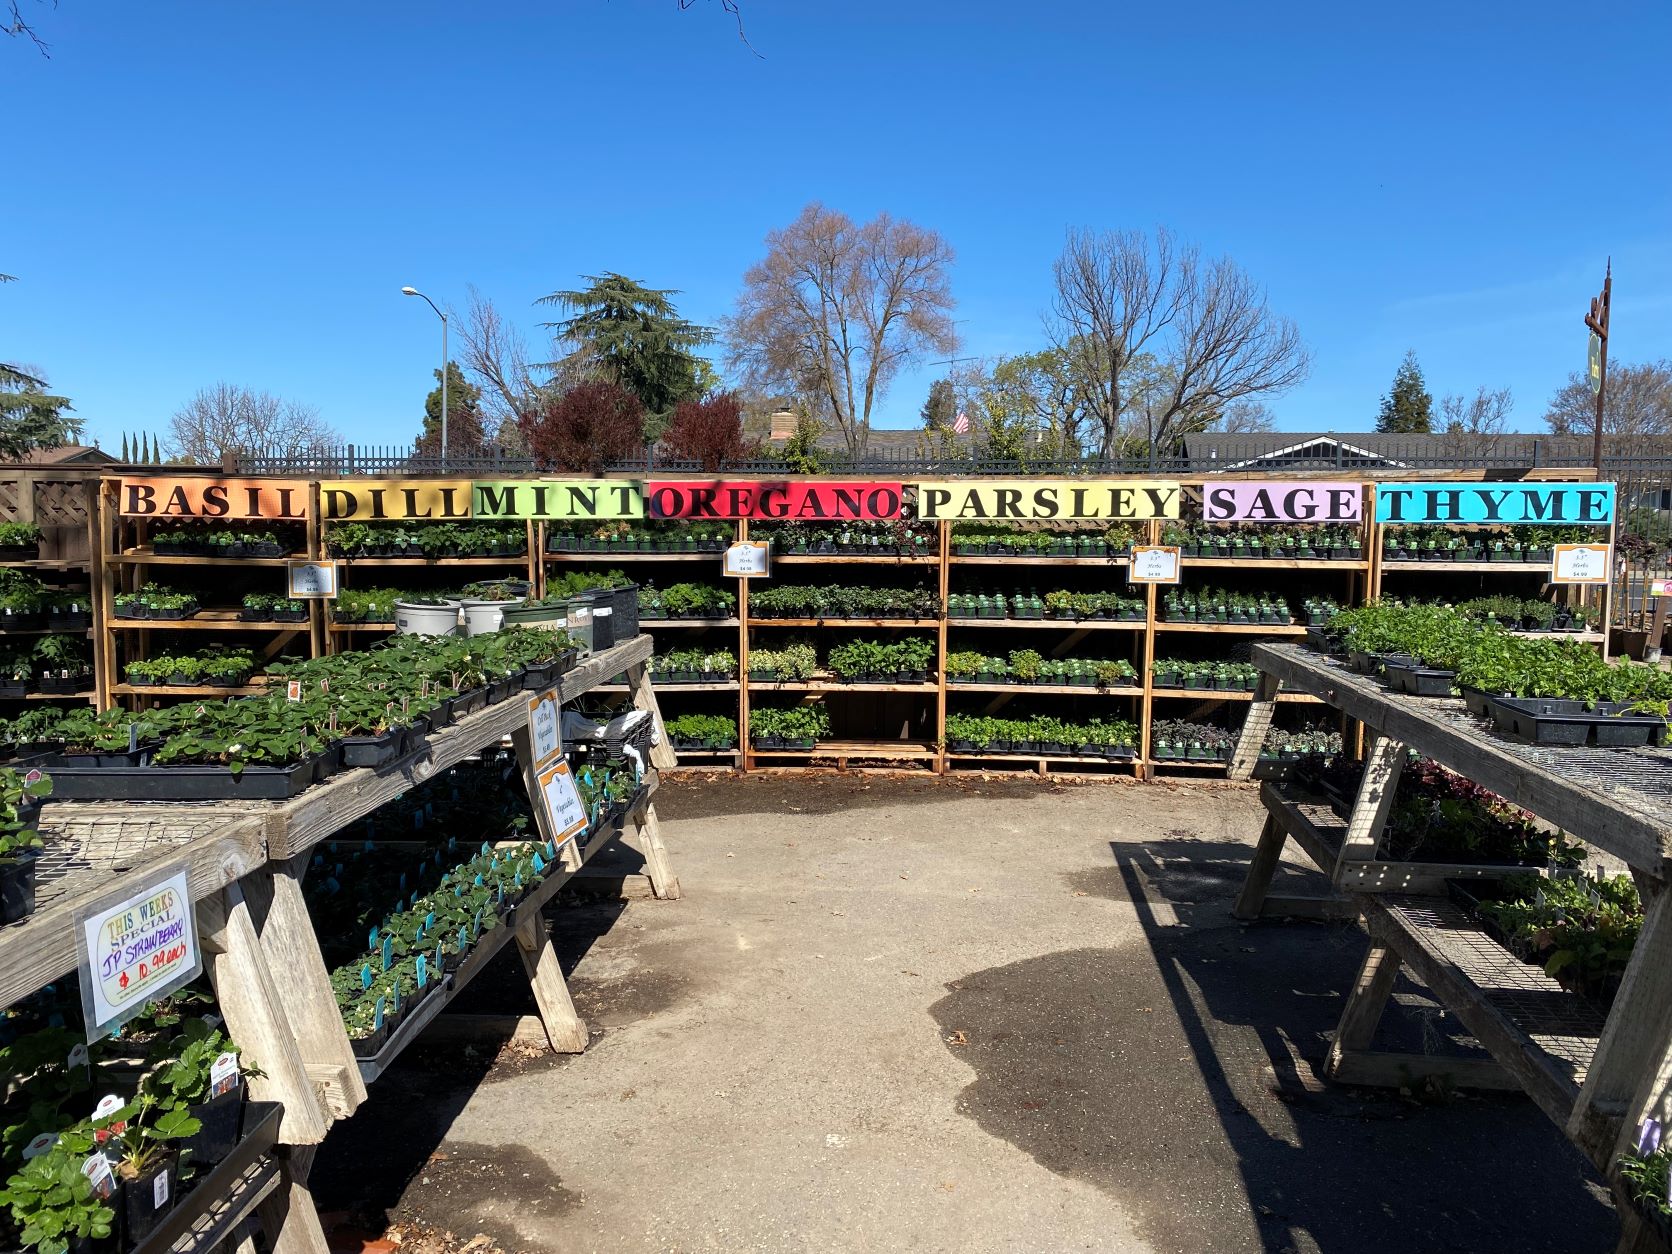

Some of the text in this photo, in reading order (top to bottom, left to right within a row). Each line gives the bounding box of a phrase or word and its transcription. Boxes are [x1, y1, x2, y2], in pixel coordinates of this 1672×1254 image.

[124, 485, 306, 519] BASIL
[323, 487, 469, 520] DILL
[474, 485, 642, 517] MINT
[651, 487, 900, 520] OREGANO
[922, 488, 1179, 519] PARSLEY
[1208, 488, 1358, 520] SAGE
[1380, 489, 1609, 522] THYME
[107, 891, 174, 939] THIS WEEKS
[110, 911, 175, 952] SPECIAL
[102, 918, 184, 978] JP STRAWBERRY
[166, 941, 187, 964] each
